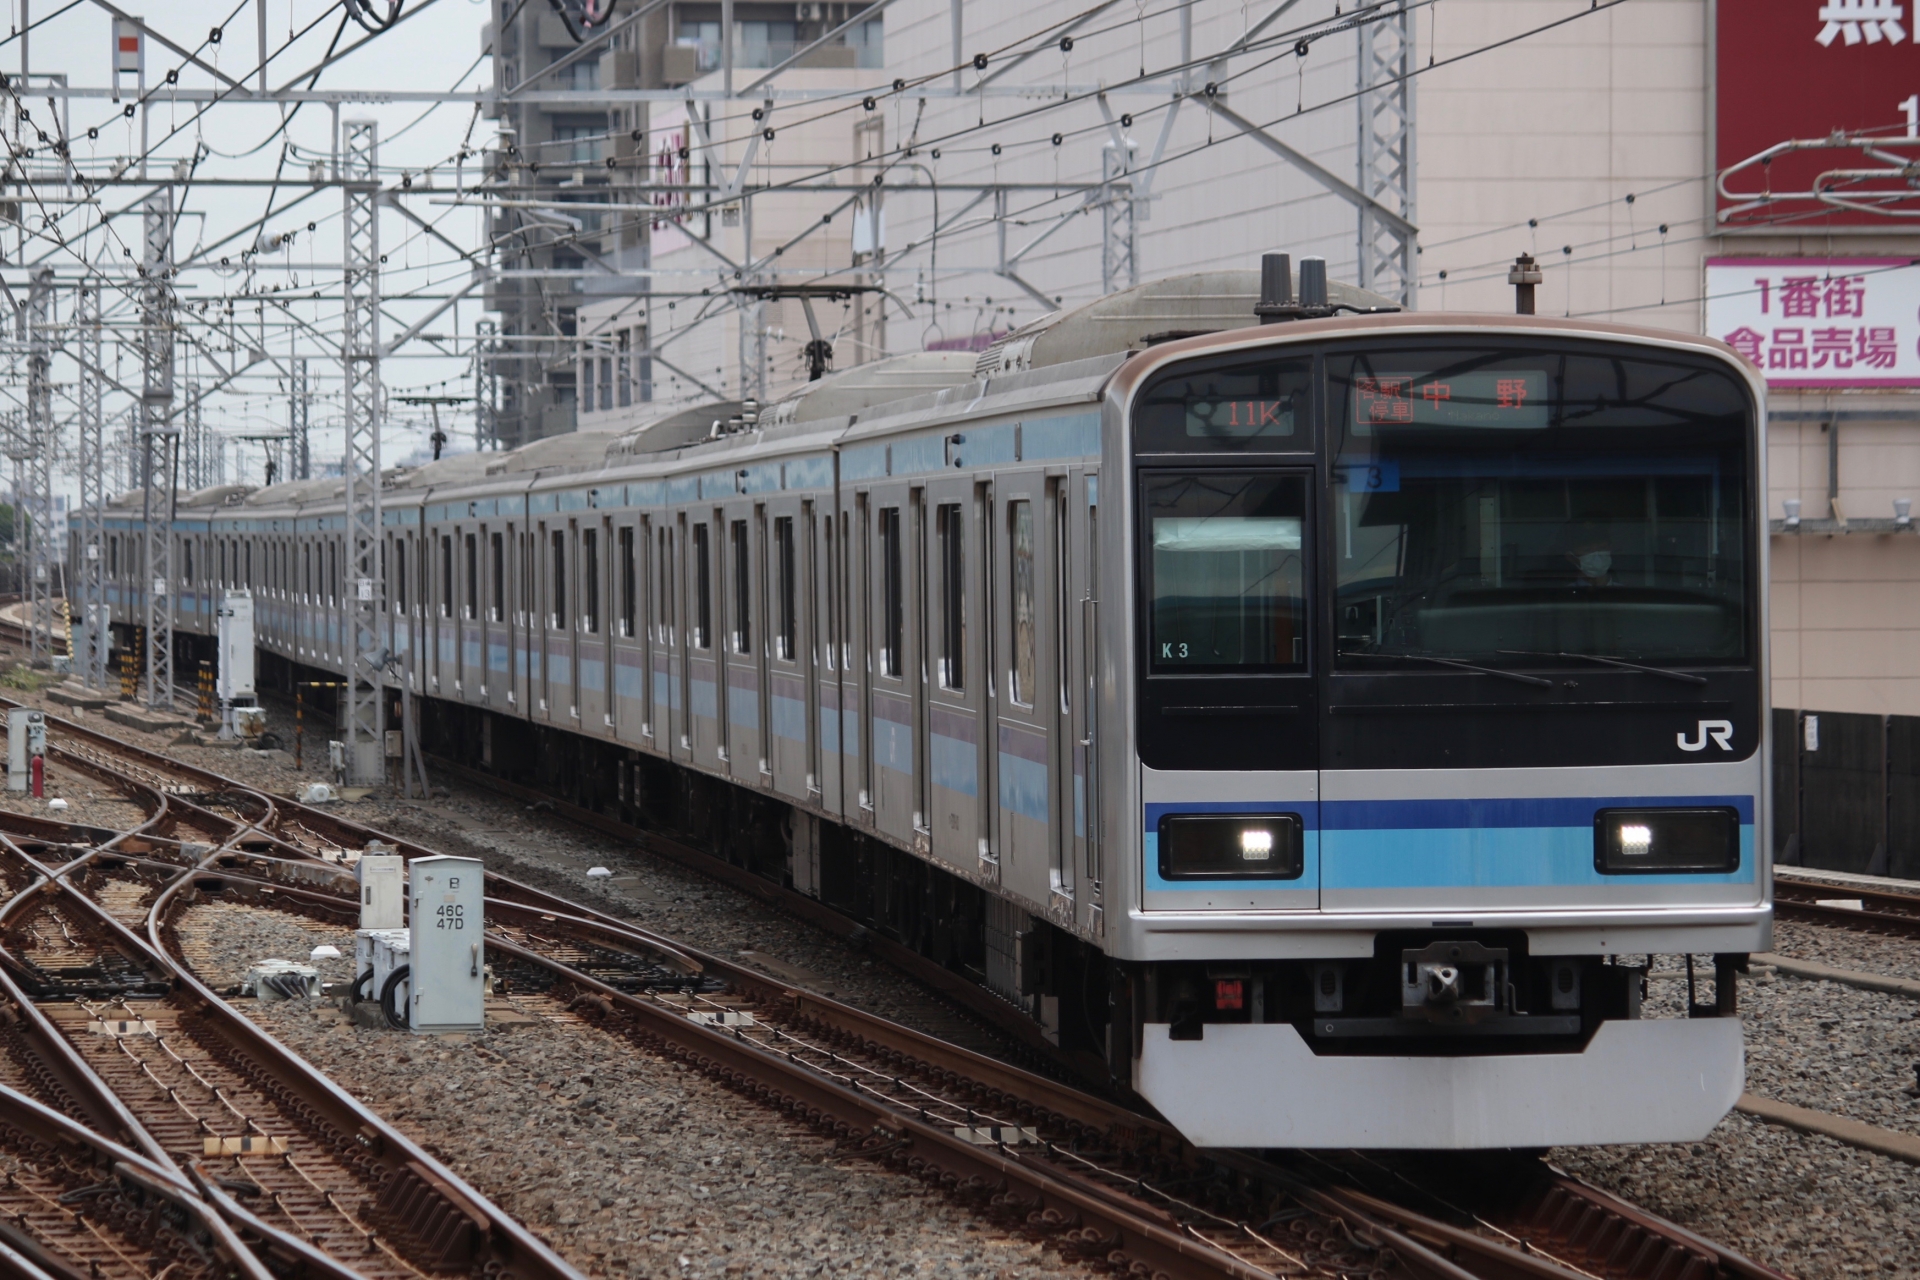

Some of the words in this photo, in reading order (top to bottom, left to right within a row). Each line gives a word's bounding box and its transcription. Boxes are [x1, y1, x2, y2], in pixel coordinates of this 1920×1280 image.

[1814, 0, 1920, 48] 無
[1754, 275, 1866, 318] 1番街
[1723, 326, 1898, 370] 食品売場
[1229, 401, 1281, 426] 11K
[1677, 719, 1734, 752] JR
[449, 877, 460, 889] B
[436, 904, 464, 917] 46C
[436, 917, 464, 930] 47D
